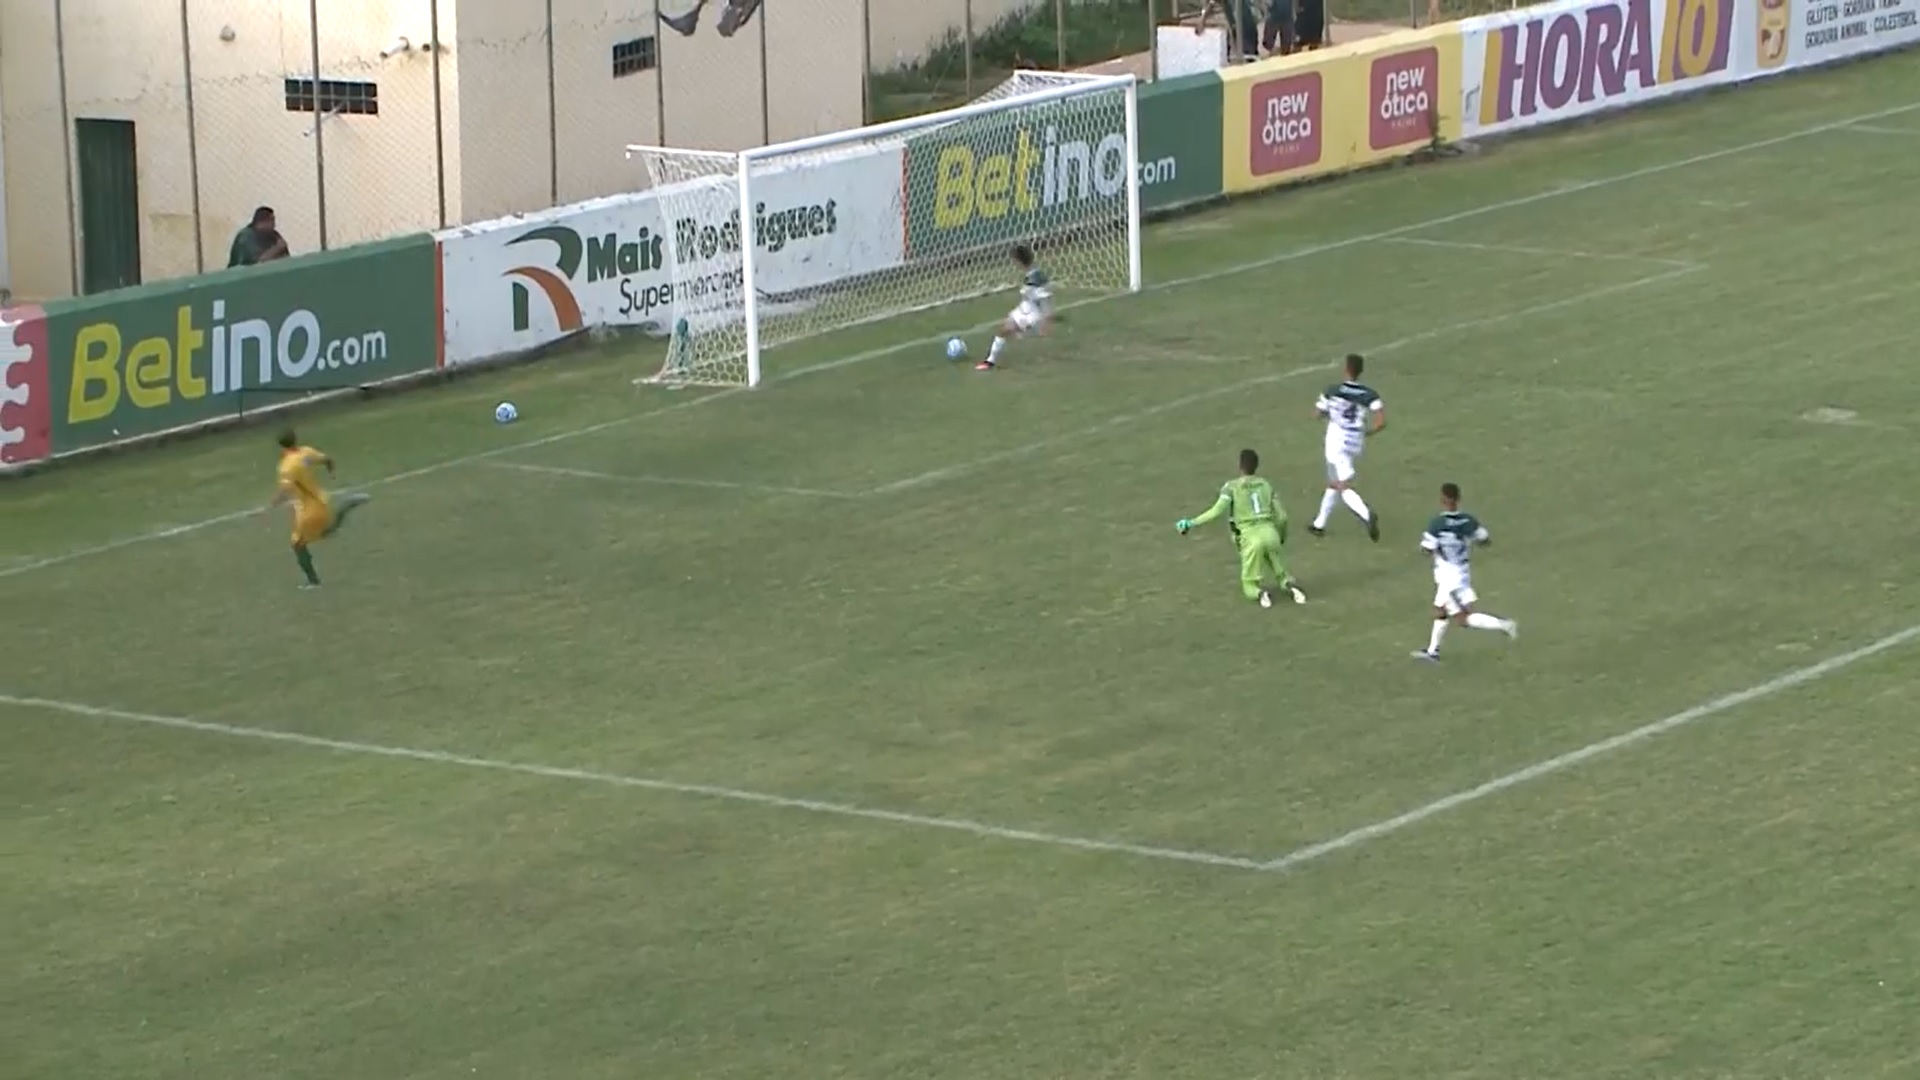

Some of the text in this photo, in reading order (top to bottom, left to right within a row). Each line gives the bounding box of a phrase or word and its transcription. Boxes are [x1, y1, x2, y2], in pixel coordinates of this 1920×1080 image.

[1386, 65, 1426, 94] new
[1496, 0, 1721, 122] HORA 10
[1267, 91, 1309, 119] new
[933, 126, 1176, 231] Betinoom
[586, 198, 837, 284] Mais Rodigues
[618, 264, 746, 316] Supermercad
[67, 299, 387, 425] Betino.com
[1342, 403, 1358, 423] 4
[1251, 491, 1261, 514] 1
